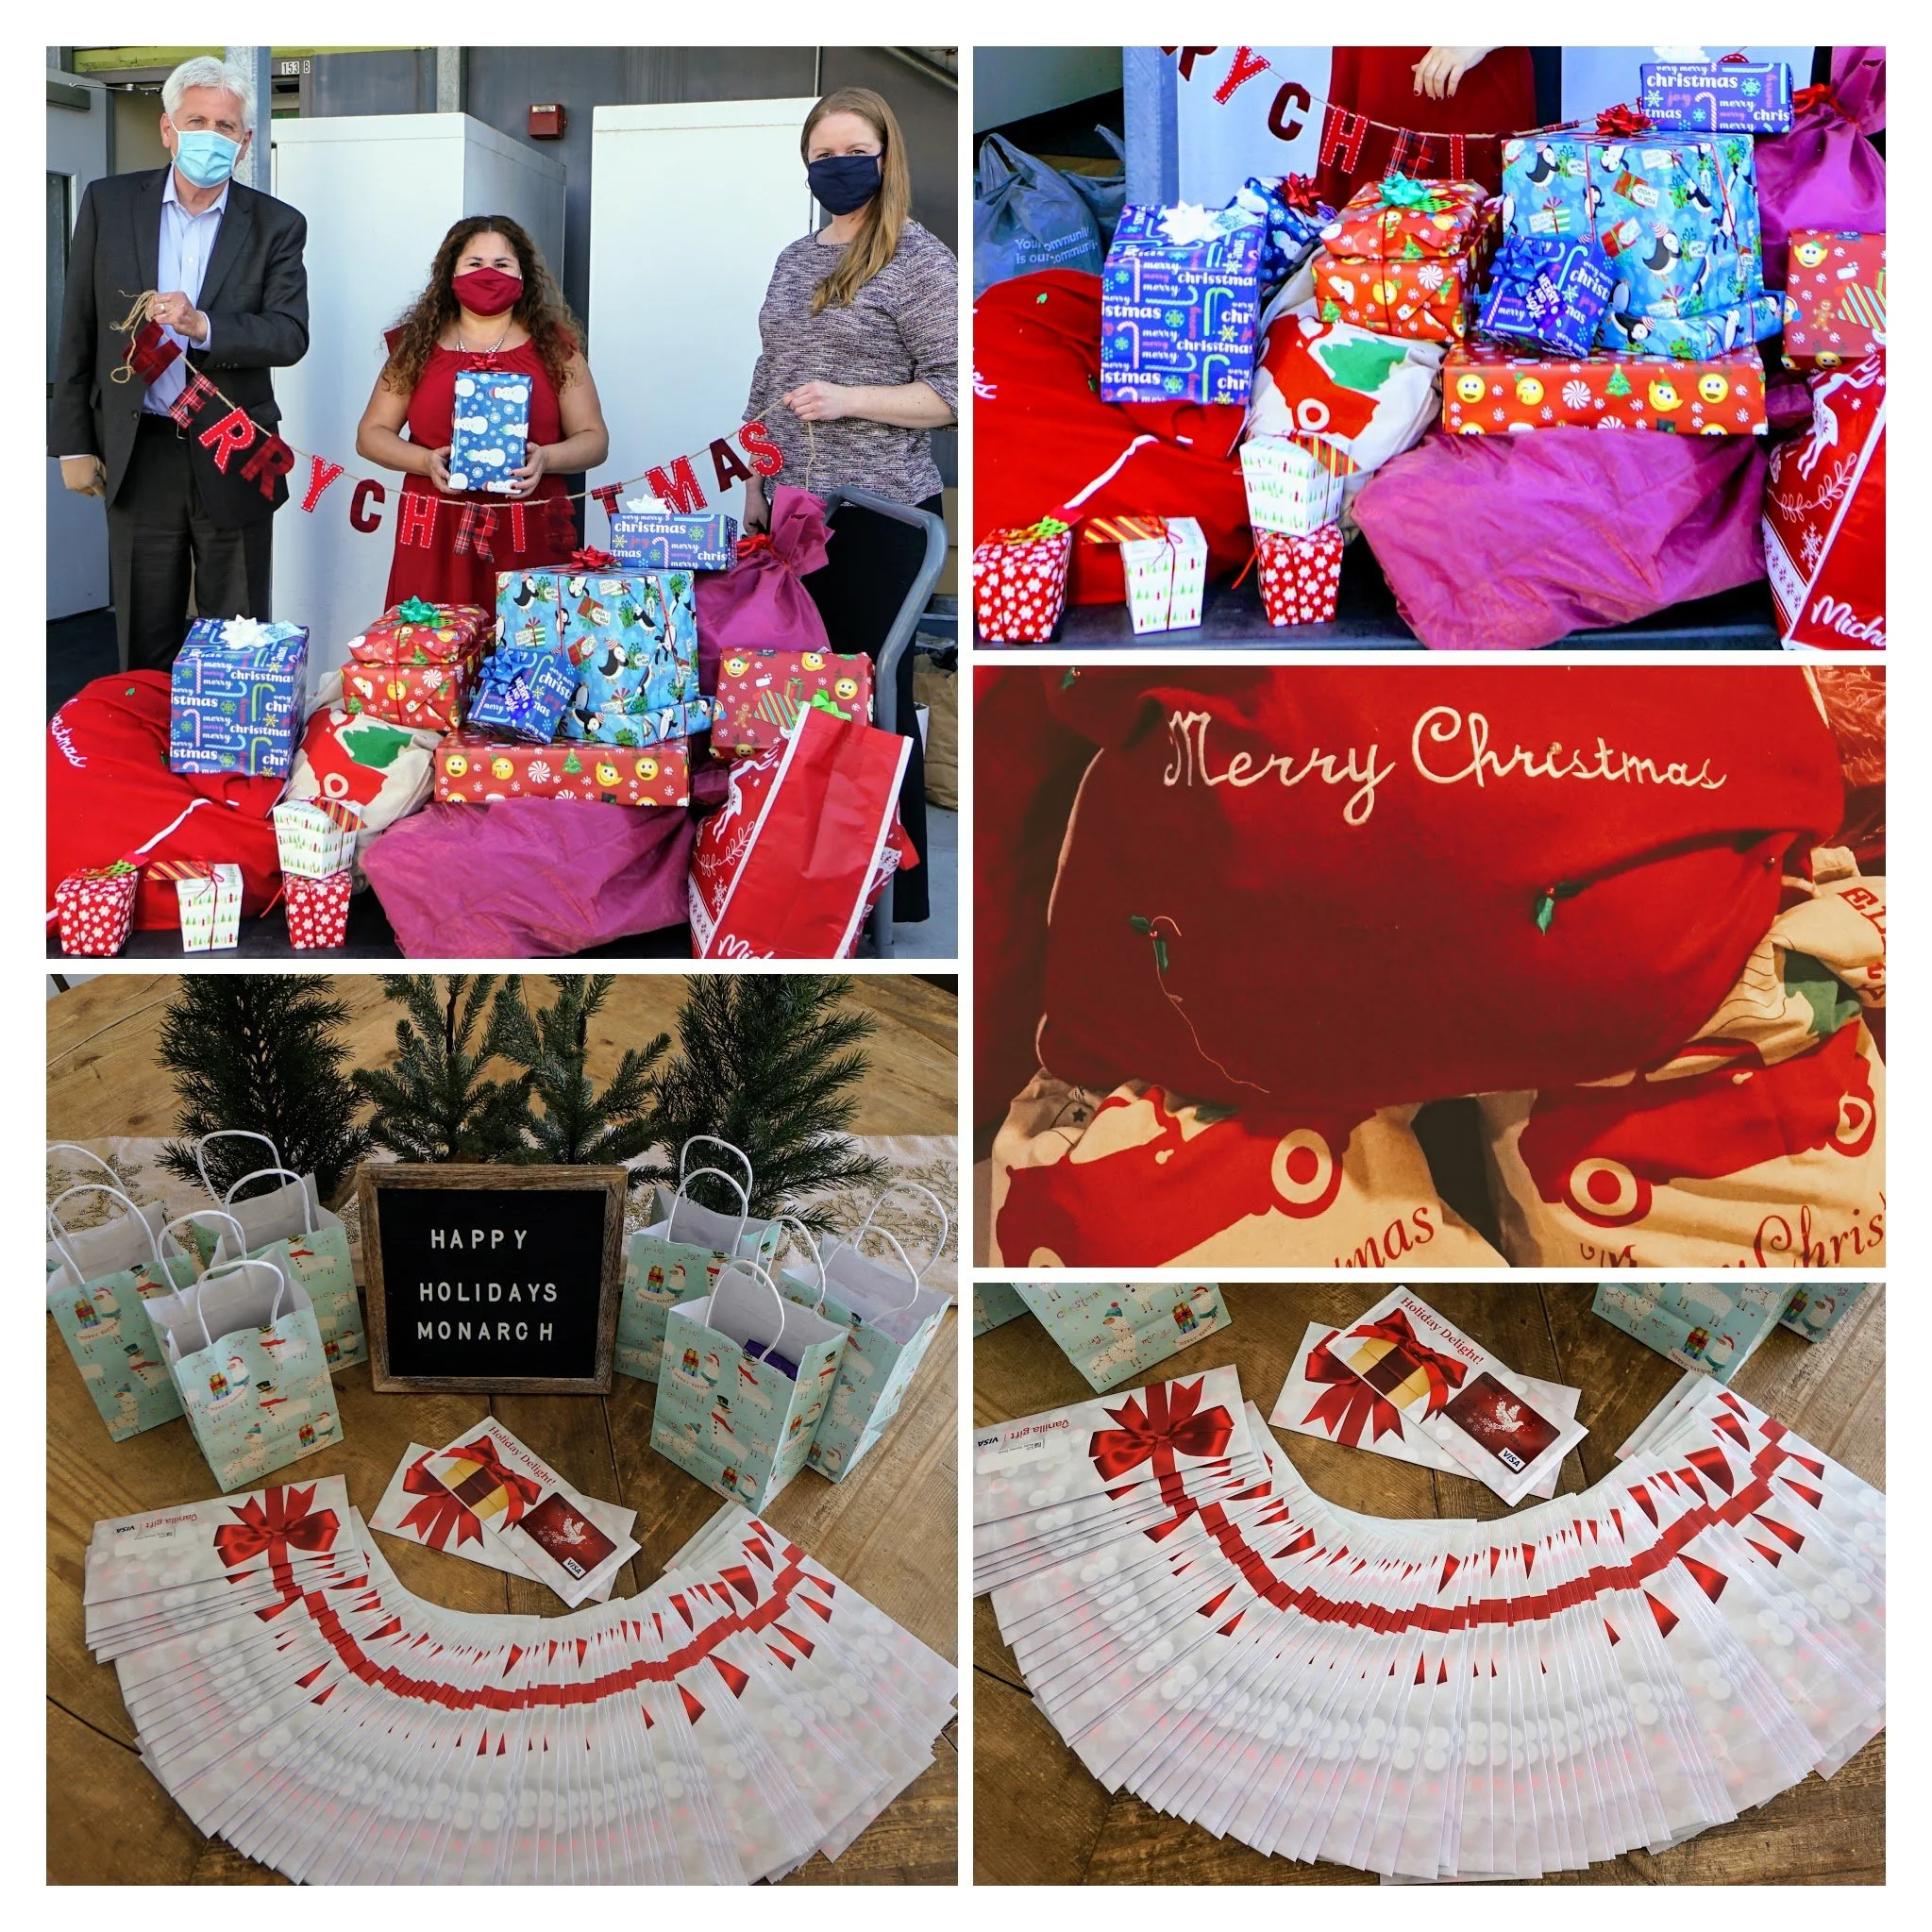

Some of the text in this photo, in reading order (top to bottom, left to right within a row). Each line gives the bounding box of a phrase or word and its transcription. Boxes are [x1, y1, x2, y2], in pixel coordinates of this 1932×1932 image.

[284, 61, 311, 75] 153 B
[1646, 73, 1739, 89] christmas
[1720, 100, 1756, 112] merry
[1719, 122, 1755, 132] merry
[1016, 253, 1027, 264] is
[1143, 261, 1181, 275] merry
[1143, 283, 1180, 296] merry
[1537, 272, 1560, 305] MERRY
[1142, 329, 1179, 342] merry
[1142, 351, 1179, 363] merry
[123, 318, 344, 512] MERRY
[614, 521, 687, 534] christmas
[671, 543, 699, 553] merry
[203, 662, 233, 672] merry
[203, 680, 233, 690] merry
[202, 715, 232, 727] merry
[202, 732, 232, 744] merry
[1163, 705, 1727, 826] Merry Christmas
[430, 1229, 528, 1250] HAPPY
[419, 1282, 558, 1302] HOLIDAYS
[1401, 1296, 1485, 1365] Holiday Delight!
[978, 1436, 999, 1447] VISA
[489, 1426, 557, 1487] Holiday Delight!
[1503, 1449, 1520, 1468] VISA
[116, 1525, 136, 1534] VISA
[566, 1559, 582, 1575] VISA
